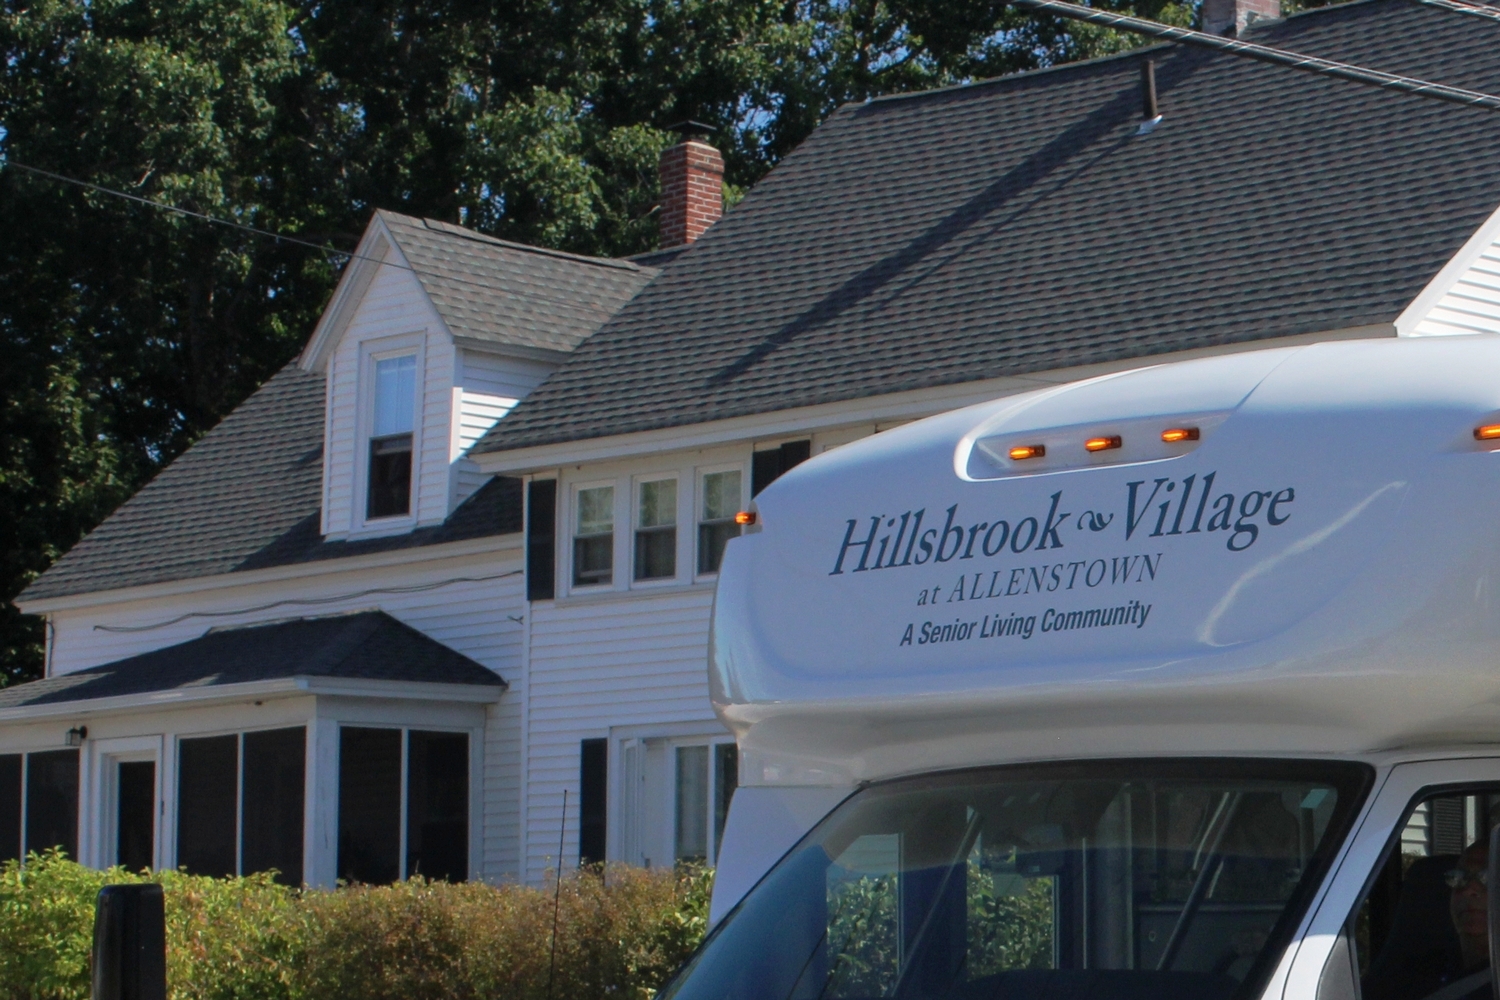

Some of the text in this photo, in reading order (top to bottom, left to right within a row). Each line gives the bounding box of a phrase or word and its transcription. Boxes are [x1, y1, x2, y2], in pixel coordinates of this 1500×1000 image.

[828, 471, 1296, 576] Hillsbrook Village
[917, 553, 1164, 606] at ALLENSTOWN
[900, 600, 1152, 647] A Senior Living Community
